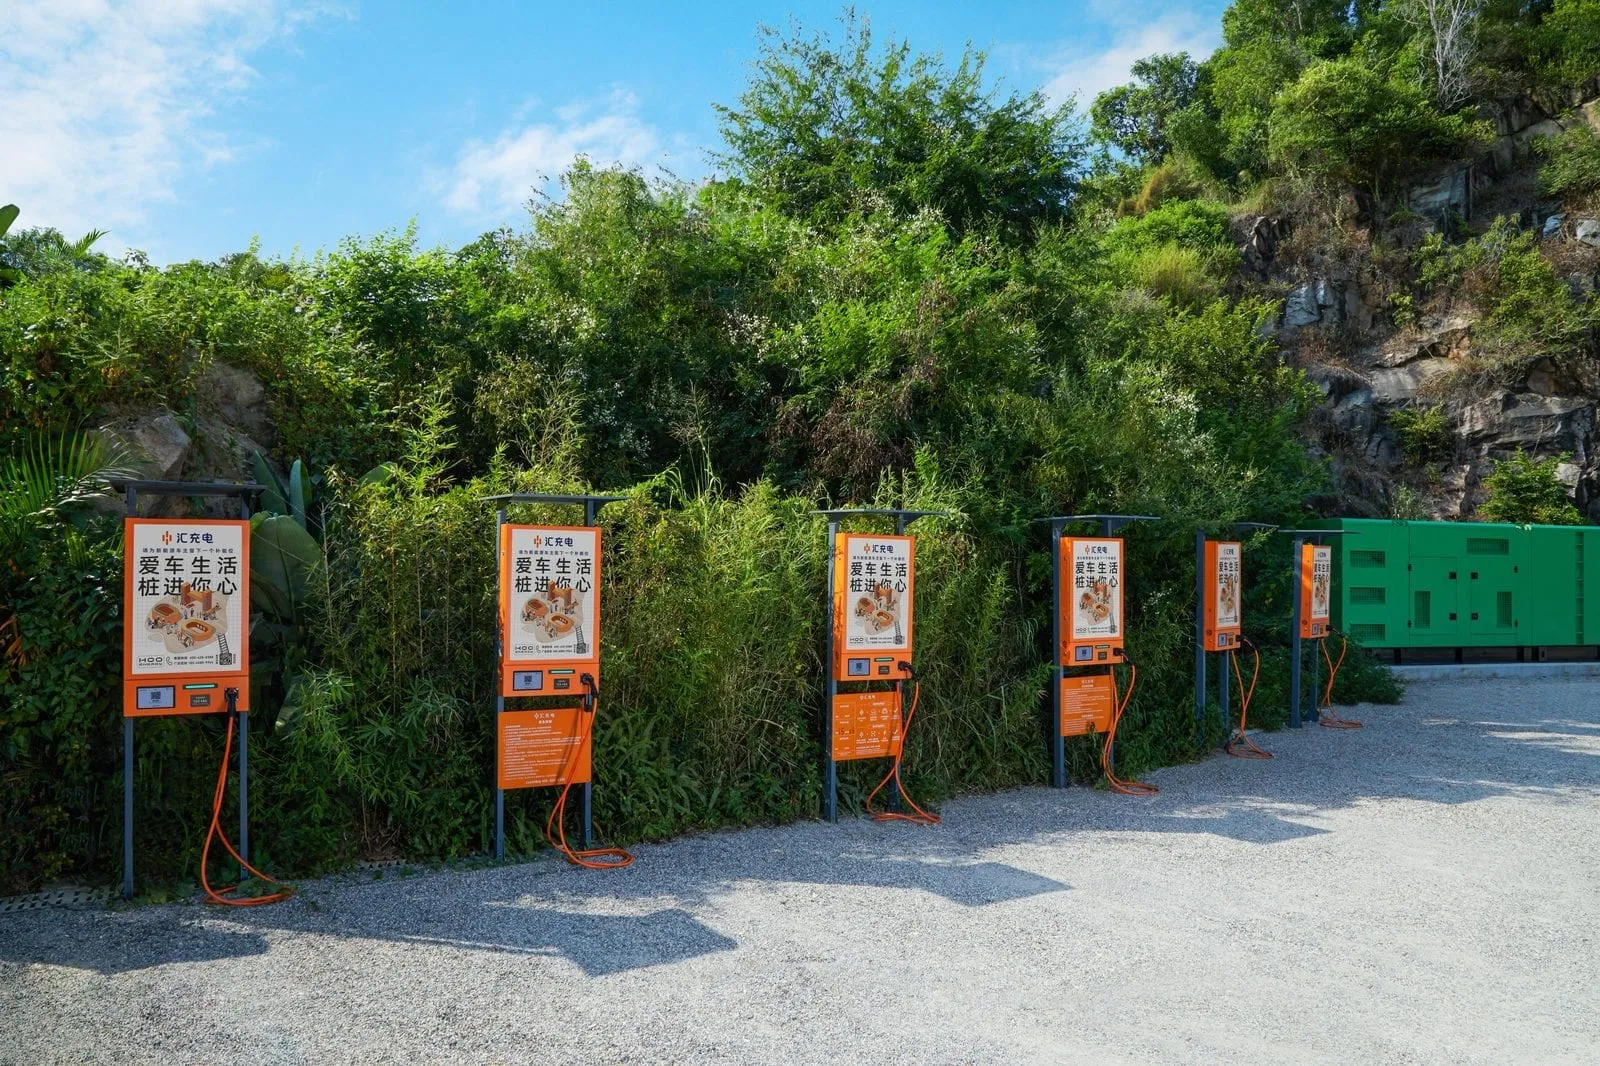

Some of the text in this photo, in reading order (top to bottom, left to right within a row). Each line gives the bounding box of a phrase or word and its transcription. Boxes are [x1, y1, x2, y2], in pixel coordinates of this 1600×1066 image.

[176, 532, 214, 544] 汇充电
[544, 536, 574, 547] 汇充电
[872, 544, 894, 554] 汇充电
[138, 555, 238, 575] 爱车生活
[515, 556, 592, 575] 爱车生活
[850, 561, 907, 577] 爱车生活
[1075, 561, 1118, 575] 爱车生活
[137, 577, 238, 597] 桩进你心
[514, 575, 592, 593] 桩进你心
